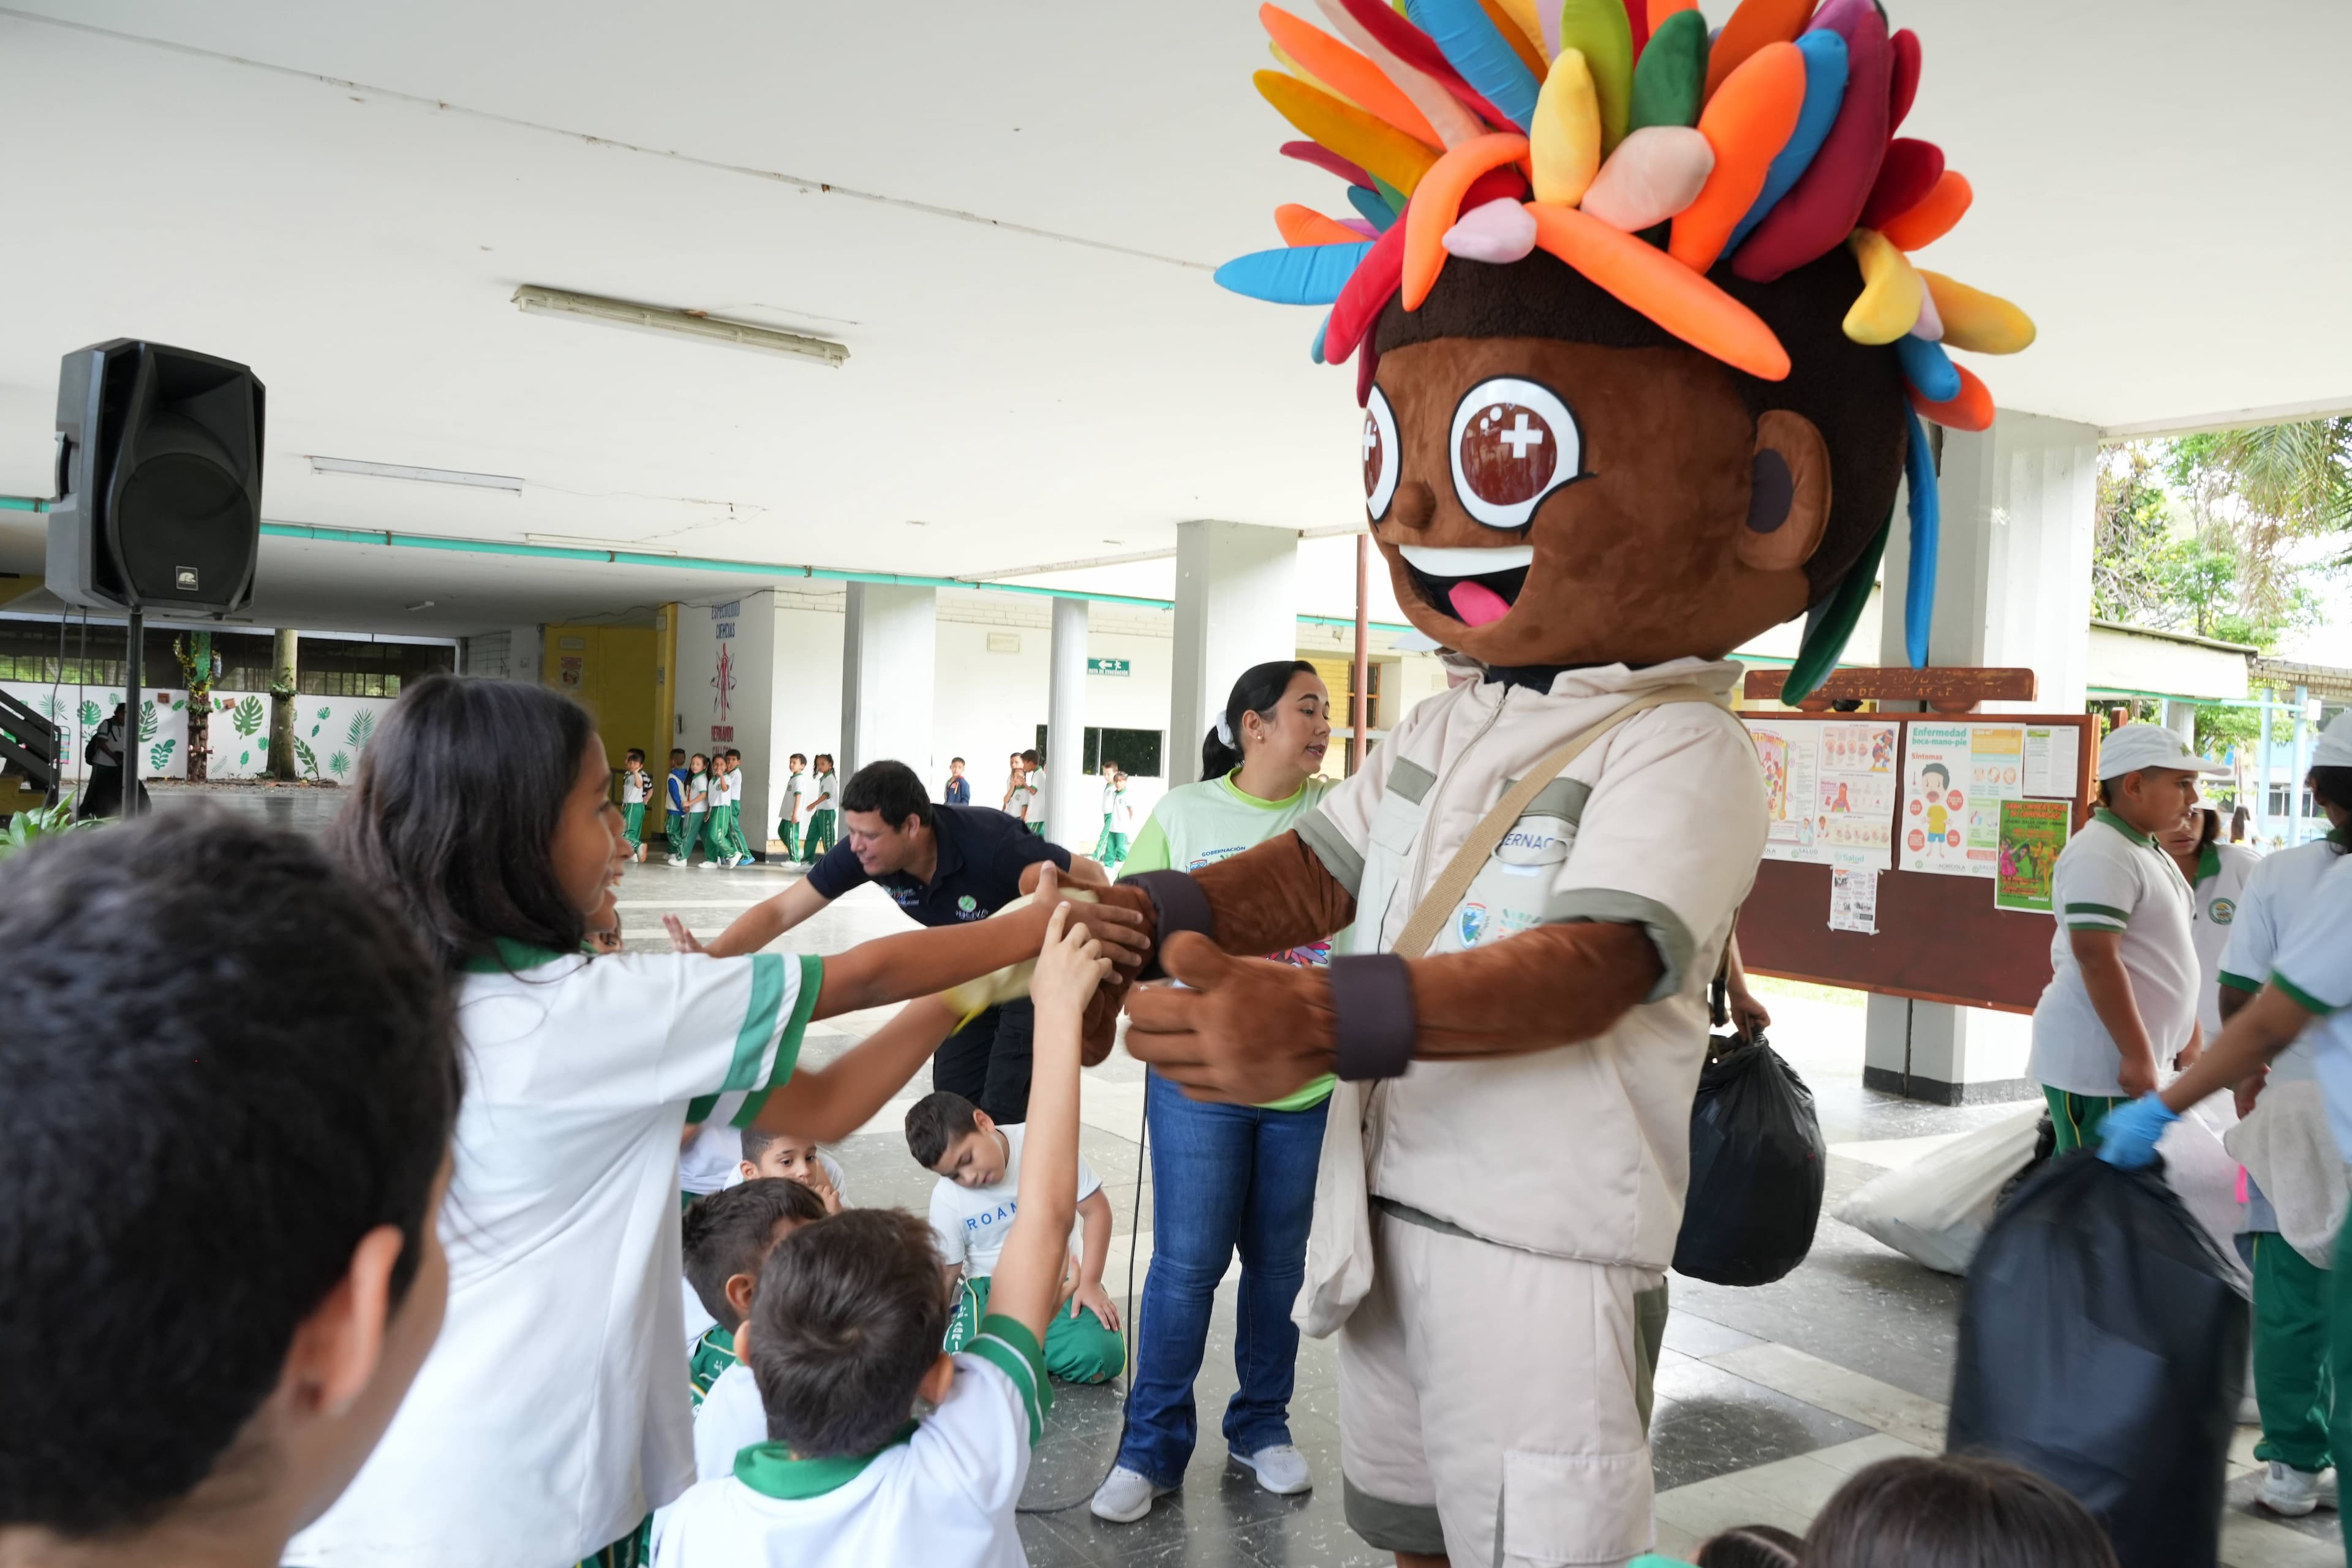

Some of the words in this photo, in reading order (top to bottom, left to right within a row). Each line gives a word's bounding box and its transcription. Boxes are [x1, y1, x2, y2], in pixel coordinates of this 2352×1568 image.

[1913, 728, 1967, 737] Enfermedad
[1912, 737, 1967, 747] boca-mano-pie
[1201, 846, 1246, 857] GOBERNACIÓN
[1842, 854, 1864, 863] Salud
